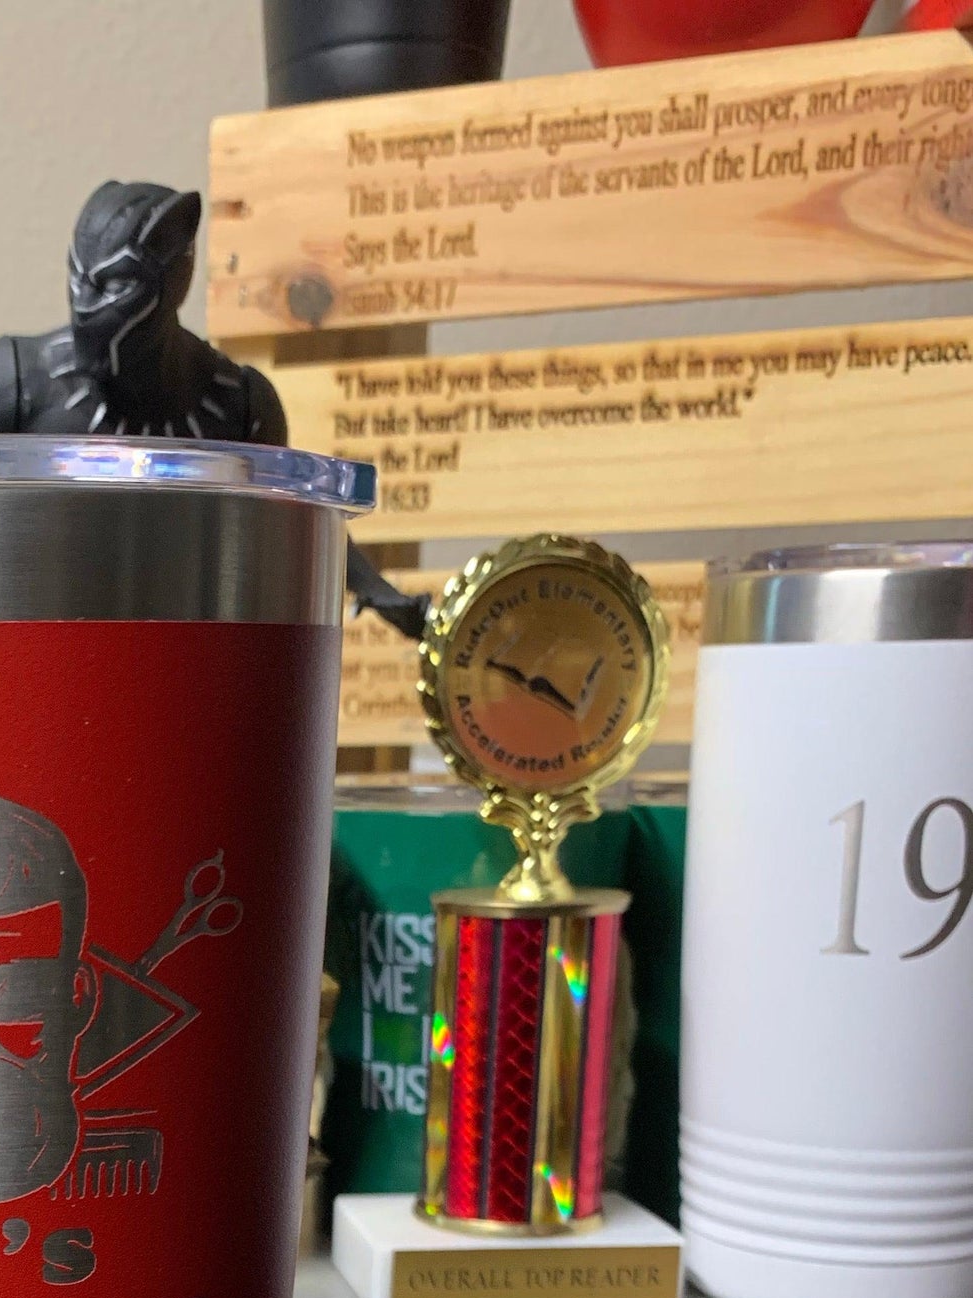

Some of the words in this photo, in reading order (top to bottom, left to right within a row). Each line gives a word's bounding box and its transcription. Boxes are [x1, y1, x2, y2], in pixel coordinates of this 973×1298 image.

[347, 132, 377, 168] No
[382, 130, 455, 170] weapon
[461, 111, 533, 154] formed
[537, 108, 608, 156] against
[613, 110, 653, 150] you
[658, 92, 709, 135] shall
[713, 96, 799, 136] prosper,
[807, 81, 847, 117] and
[853, 83, 915, 121] every
[347, 183, 387, 218] This
[392, 180, 408, 214] is
[414, 175, 443, 212] the
[448, 169, 525, 213] heritage
[531, 163, 556, 201] of
[559, 162, 588, 198] the
[594, 155, 678, 196] servants
[684, 148, 711, 186] of
[712, 145, 745, 183] the
[751, 137, 809, 181] Lord,
[815, 131, 856, 171] and
[862, 128, 914, 167] their
[343, 231, 387, 274] Says
[392, 227, 422, 264] the
[357, 367, 399, 398] have
[406, 363, 444, 395] told
[447, 371, 482, 402] you
[488, 360, 536, 391] these
[614, 361, 637, 384] so
[642, 350, 679, 381] that
[686, 351, 705, 379] in
[712, 355, 744, 377] me
[746, 355, 789, 385] you
[795, 350, 842, 378] may
[847, 334, 898, 369] have
[335, 410, 367, 438] But
[372, 407, 409, 436] take
[488, 400, 533, 431] have
[538, 403, 634, 429] overcome
[640, 389, 672, 423] the
[455, 693, 565, 773] Accelerated
[361, 964, 419, 1015] ME
[408, 1267, 514, 1293] OVERALL
[524, 1267, 565, 1290] TOP
[570, 1264, 660, 1288] READER
